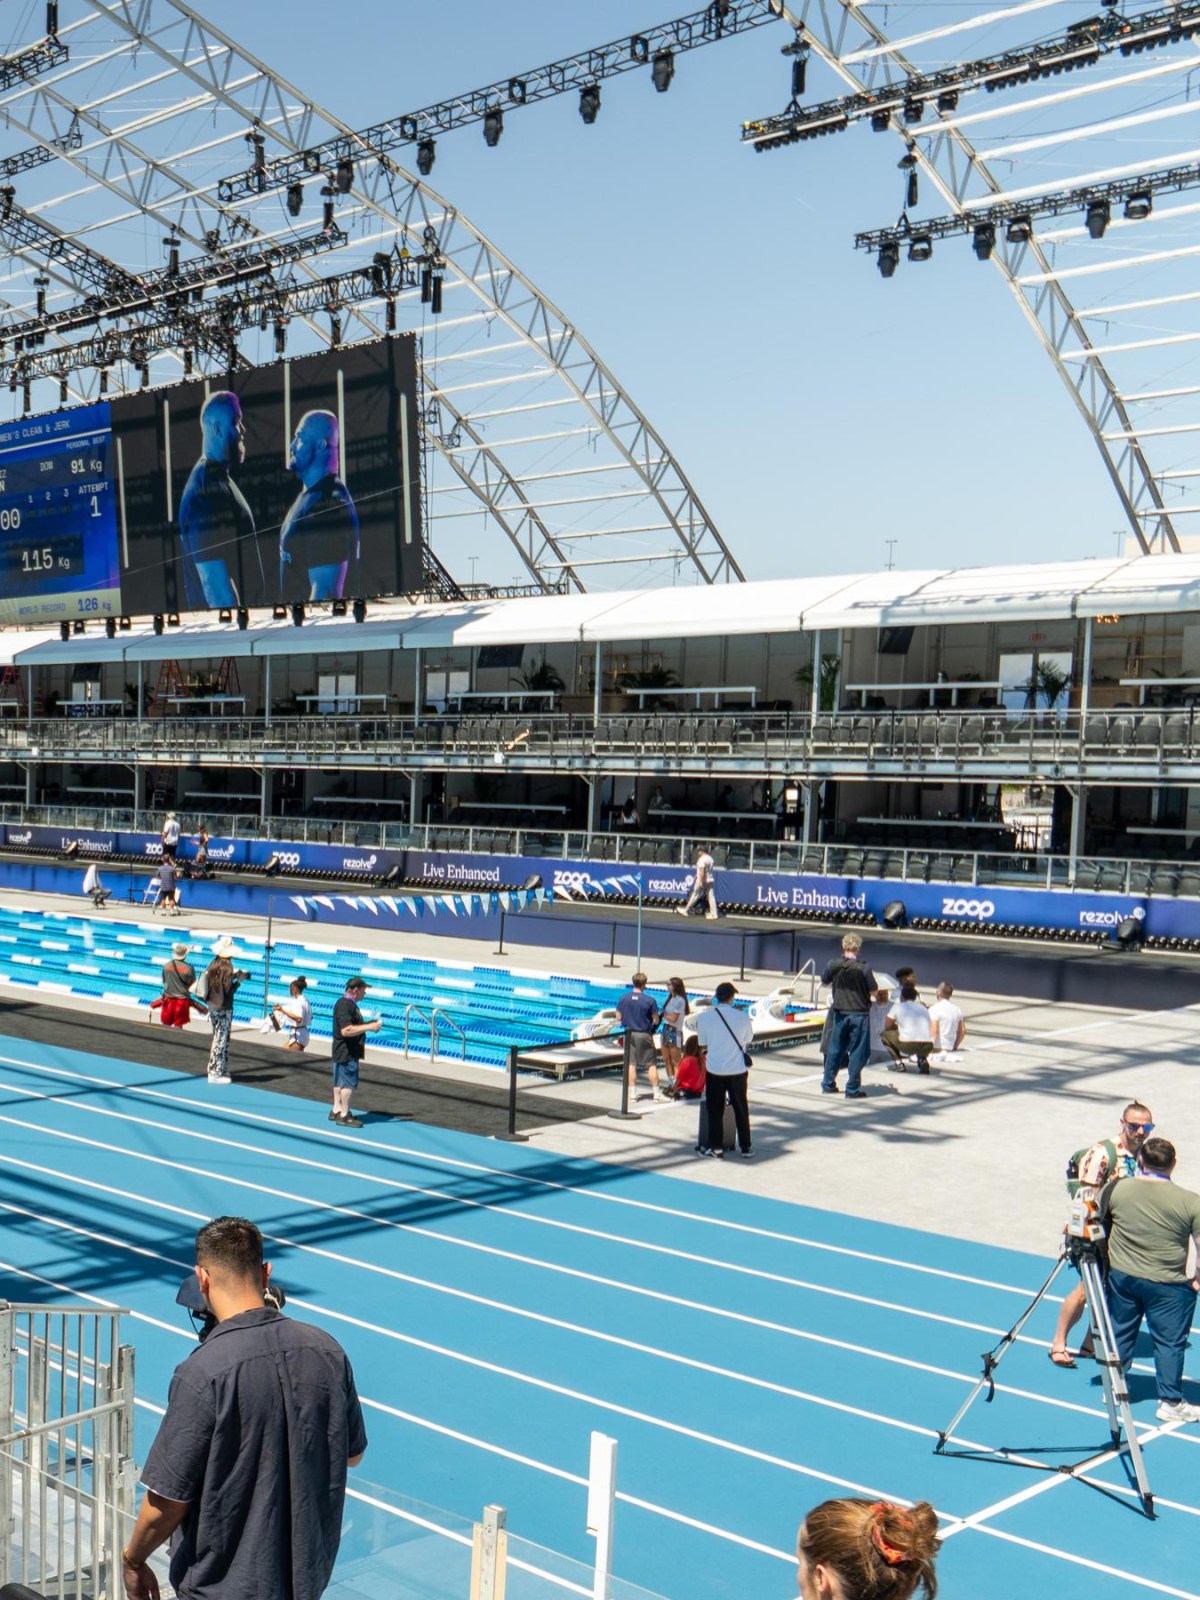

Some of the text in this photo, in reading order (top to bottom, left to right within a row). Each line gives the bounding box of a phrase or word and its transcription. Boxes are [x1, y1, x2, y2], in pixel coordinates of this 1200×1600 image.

[22, 427, 43, 438] CLEAN
[53, 420, 71, 431] JERK
[93, 436, 105, 445] BEST
[71, 459, 103, 474] 91 Kg
[79, 482, 108, 495] ATTEMPT
[28, 489, 69, 503] 1 2 3
[90, 495, 102, 517] 1
[22, 549, 70, 572] 115 Kg
[78, 598, 98, 612] 126
[78, 838, 112, 852] Enhanced
[145, 843, 163, 855] zoo
[208, 847, 231, 858] ezolve
[343, 857, 372, 869] rezolve
[423, 863, 500, 882] Live Enhanced
[649, 878, 687, 890] rezolve
[757, 886, 865, 910] Live Enhanced
[942, 898, 995, 920] zoop
[1079, 910, 1131, 925] rezolv
